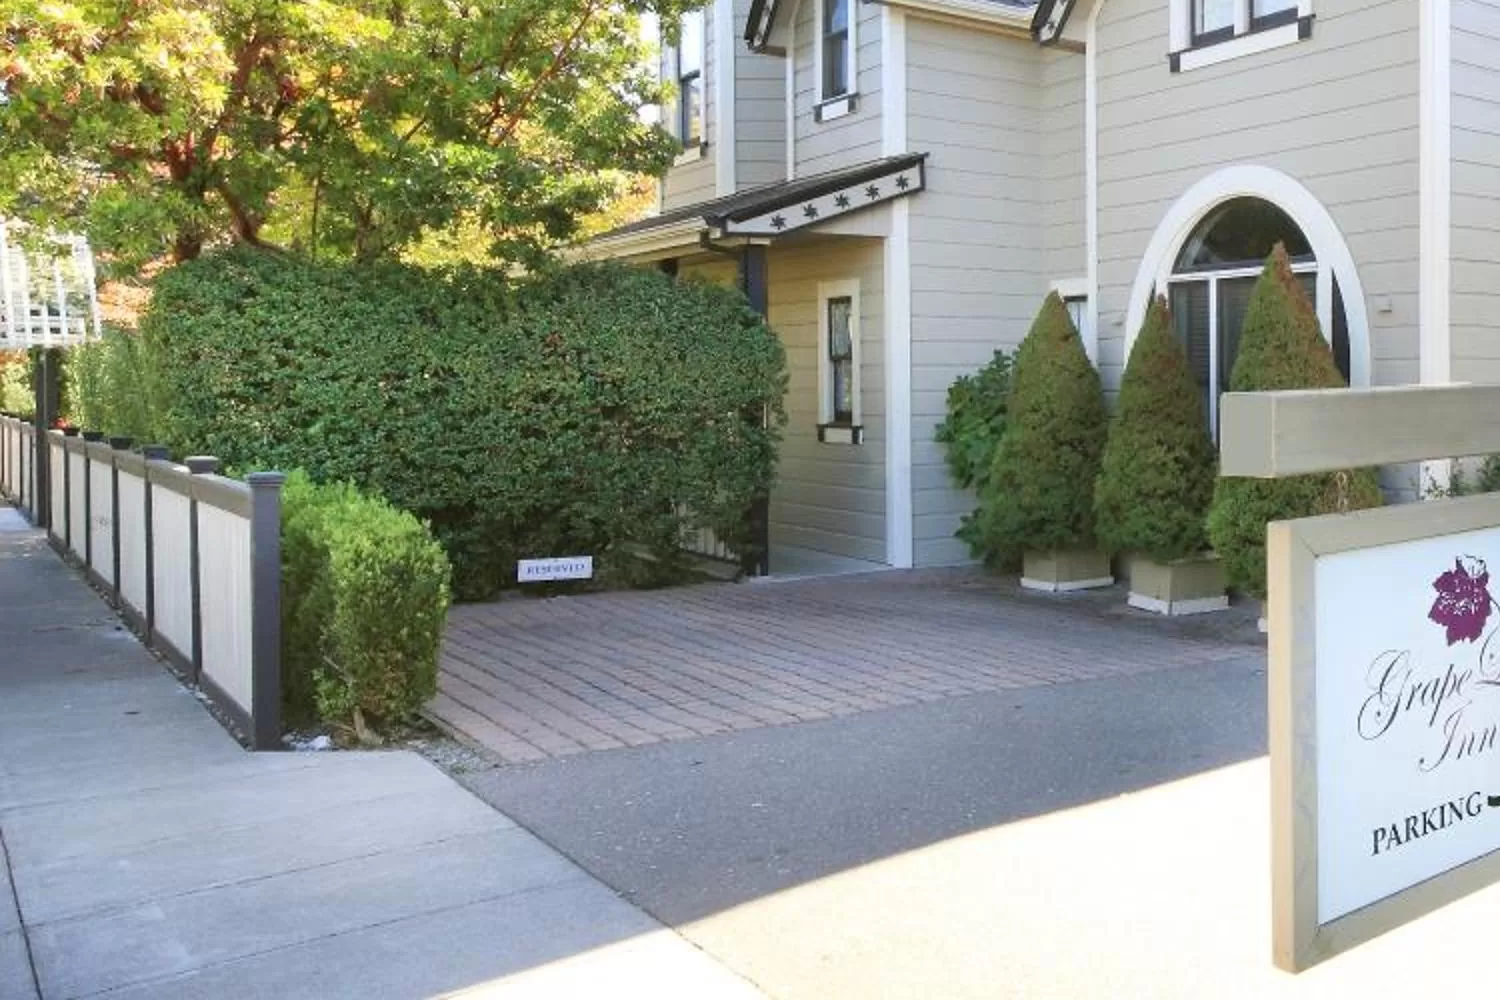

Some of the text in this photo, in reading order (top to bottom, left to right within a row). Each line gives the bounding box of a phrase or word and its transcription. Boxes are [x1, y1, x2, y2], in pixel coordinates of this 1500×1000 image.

[527, 563, 585, 574] RESERVED
[1357, 649, 1473, 740] Grape
[1419, 701, 1498, 772] Inn
[1372, 791, 1483, 856] PARKING
